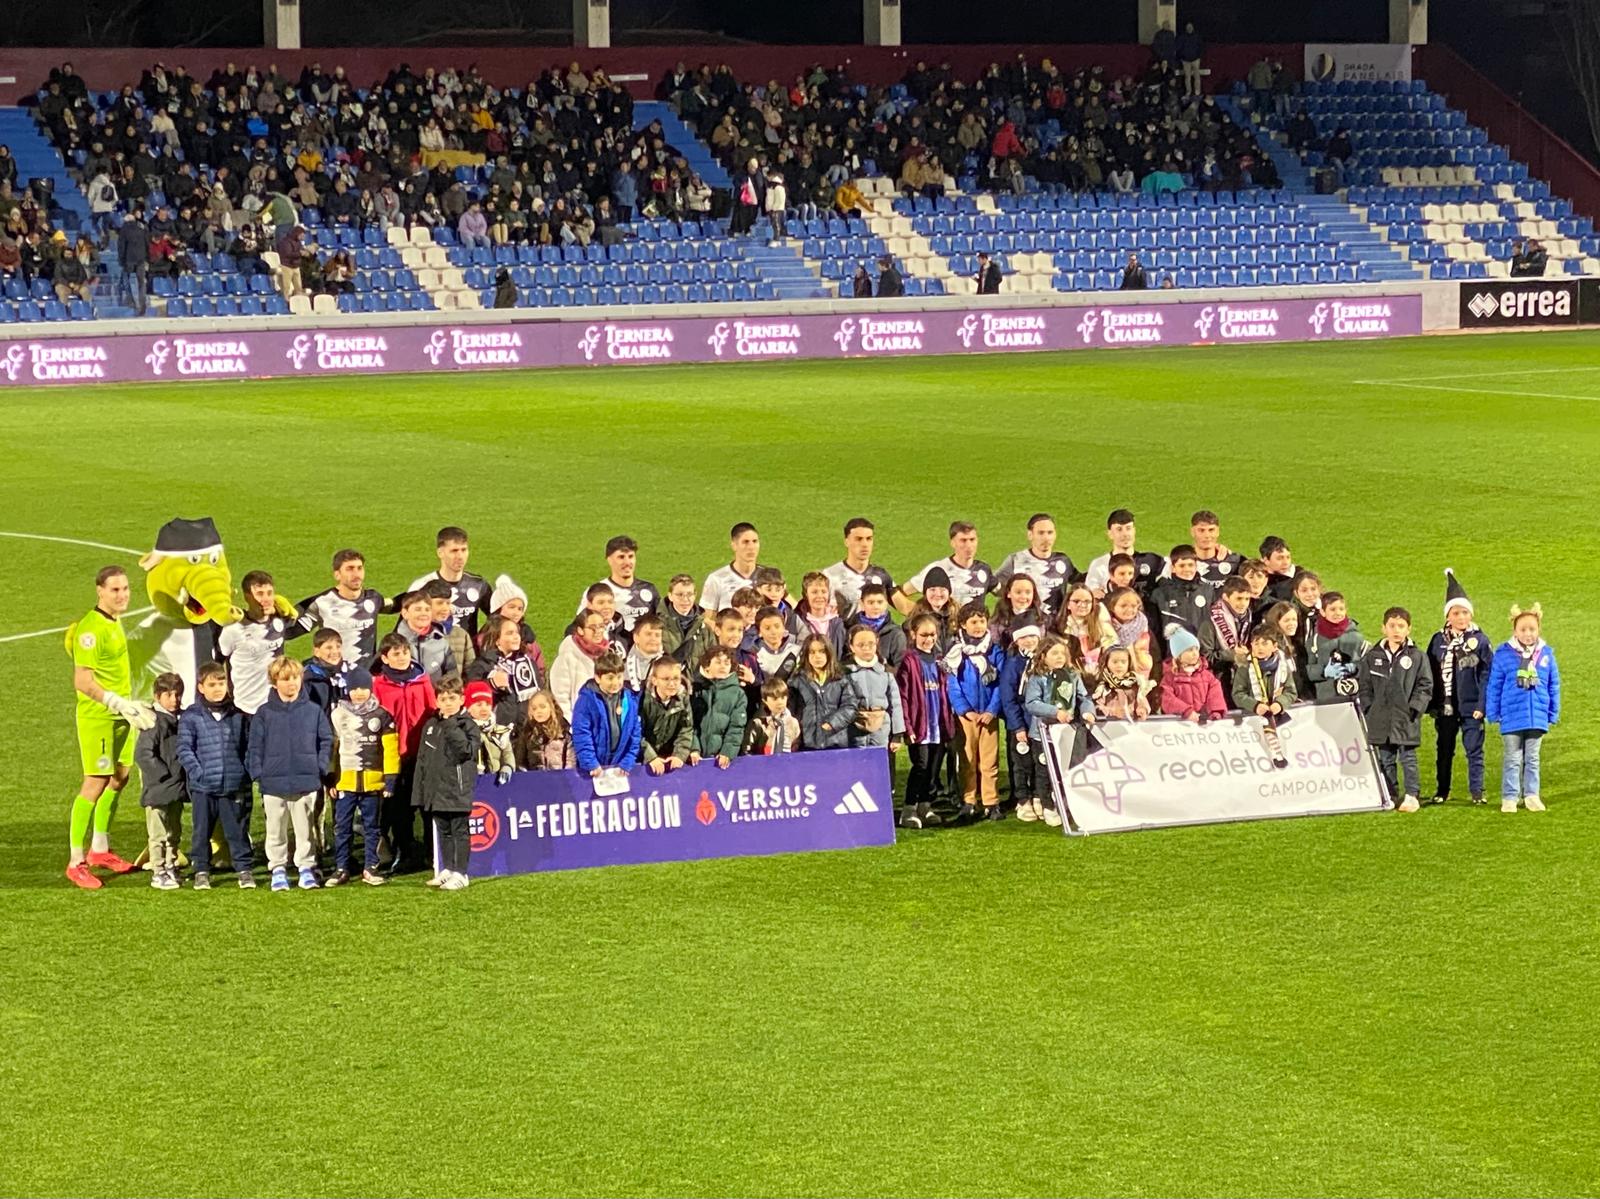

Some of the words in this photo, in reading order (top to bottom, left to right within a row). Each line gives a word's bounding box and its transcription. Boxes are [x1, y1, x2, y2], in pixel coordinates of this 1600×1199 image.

[1332, 302, 1392, 319] TERNERA
[1500, 290, 1571, 318] errea
[981, 314, 1046, 331] TERNERA
[1101, 310, 1164, 327] TERNERA
[1218, 306, 1280, 324] TERNERA
[605, 325, 674, 344] TERNERA
[734, 322, 801, 340] TERNERA
[859, 318, 925, 335] TERNERA
[1104, 326, 1161, 343] CHARRA
[1220, 322, 1276, 338] CHARRA
[1334, 318, 1388, 334] CHARRA
[314, 334, 388, 353] TERNERA
[451, 330, 523, 349] TERNERA
[862, 334, 922, 351] CHARRA
[984, 330, 1042, 347] CHARRA
[29, 344, 108, 363] TERNERA
[174, 339, 250, 359] TERNERA
[608, 343, 671, 360] CHARRA
[736, 339, 797, 356] CHARRA
[318, 352, 384, 369] CHARRA
[454, 348, 519, 365] CHARRA
[33, 362, 104, 380] CHARRA
[178, 357, 246, 375] CHARRA
[1151, 732, 1220, 748] CENTRO
[1158, 748, 1286, 782] recoleta
[1294, 739, 1361, 769] salud
[1258, 776, 1369, 798] CAMPOAMOR
[717, 784, 818, 812] VERSUS
[536, 791, 681, 837] FEDERACIÓN
[731, 807, 810, 823] E-LEARNING
